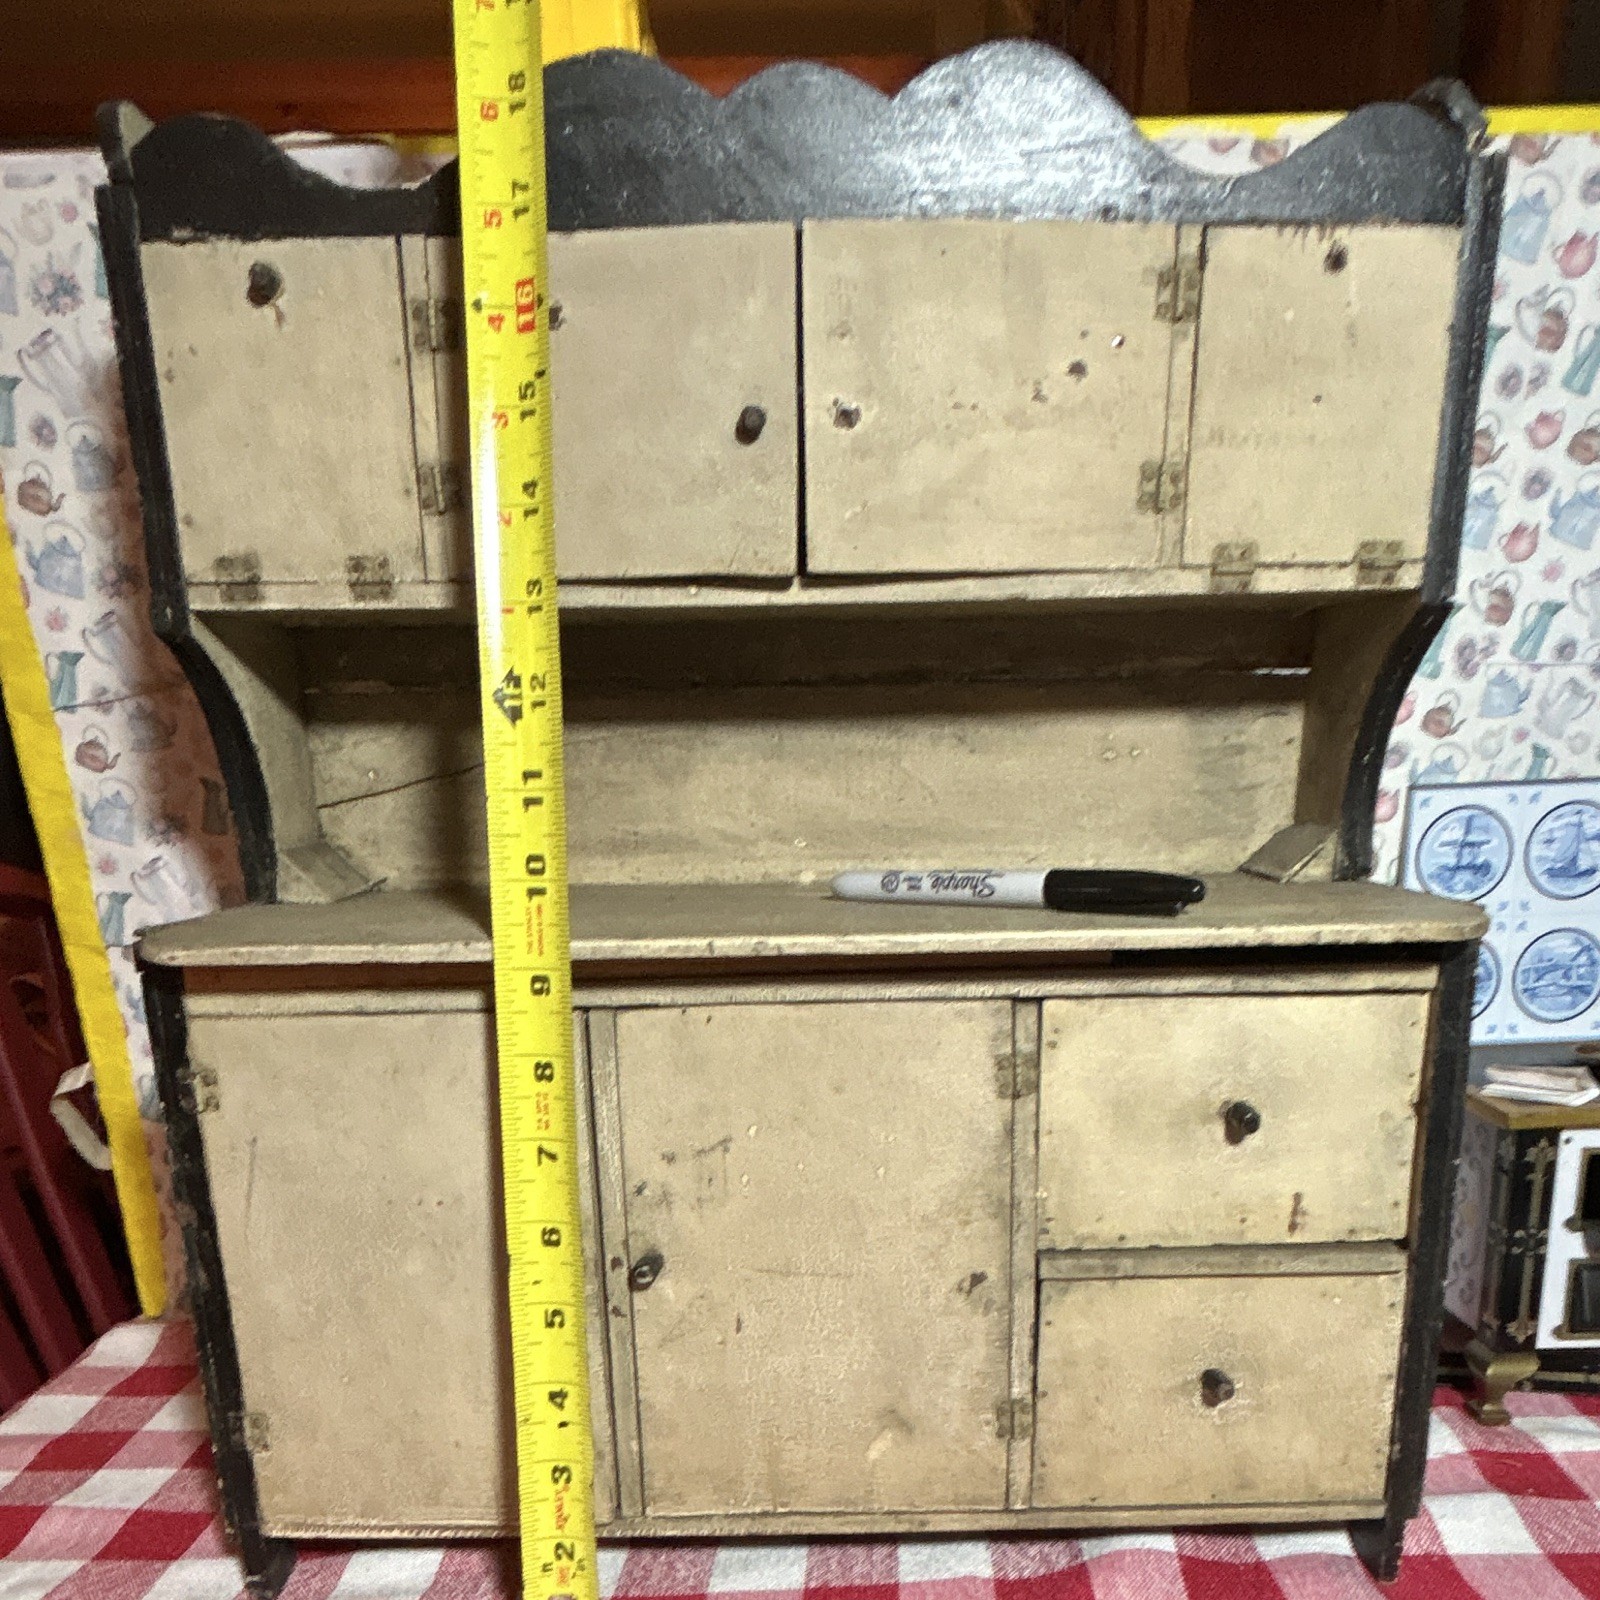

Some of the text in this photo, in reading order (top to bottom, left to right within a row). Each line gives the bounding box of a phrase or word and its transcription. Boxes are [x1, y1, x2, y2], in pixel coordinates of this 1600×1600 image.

[508, 70, 526, 116] 18
[480, 101, 499, 121] 6
[511, 180, 530, 221] 17
[484, 209, 502, 228] 5
[515, 278, 535, 332] 16
[488, 313, 504, 334] 4
[519, 380, 536, 422] 15
[522, 479, 539, 521] 14
[526, 577, 543, 617] 13
[529, 672, 547, 712] 12
[522, 769, 542, 813] 11
[525, 853, 547, 903] 10
[929, 873, 998, 898] Sharpie
[530, 975, 551, 997] 9
[534, 1060, 554, 1083] 8
[537, 1145, 558, 1166] 7
[541, 1226, 562, 1247] 6
[544, 1308, 565, 1329] 5
[548, 1388, 568, 1411] 4
[551, 1464, 572, 1485] 3
[554, 1541, 575, 1561] 2
